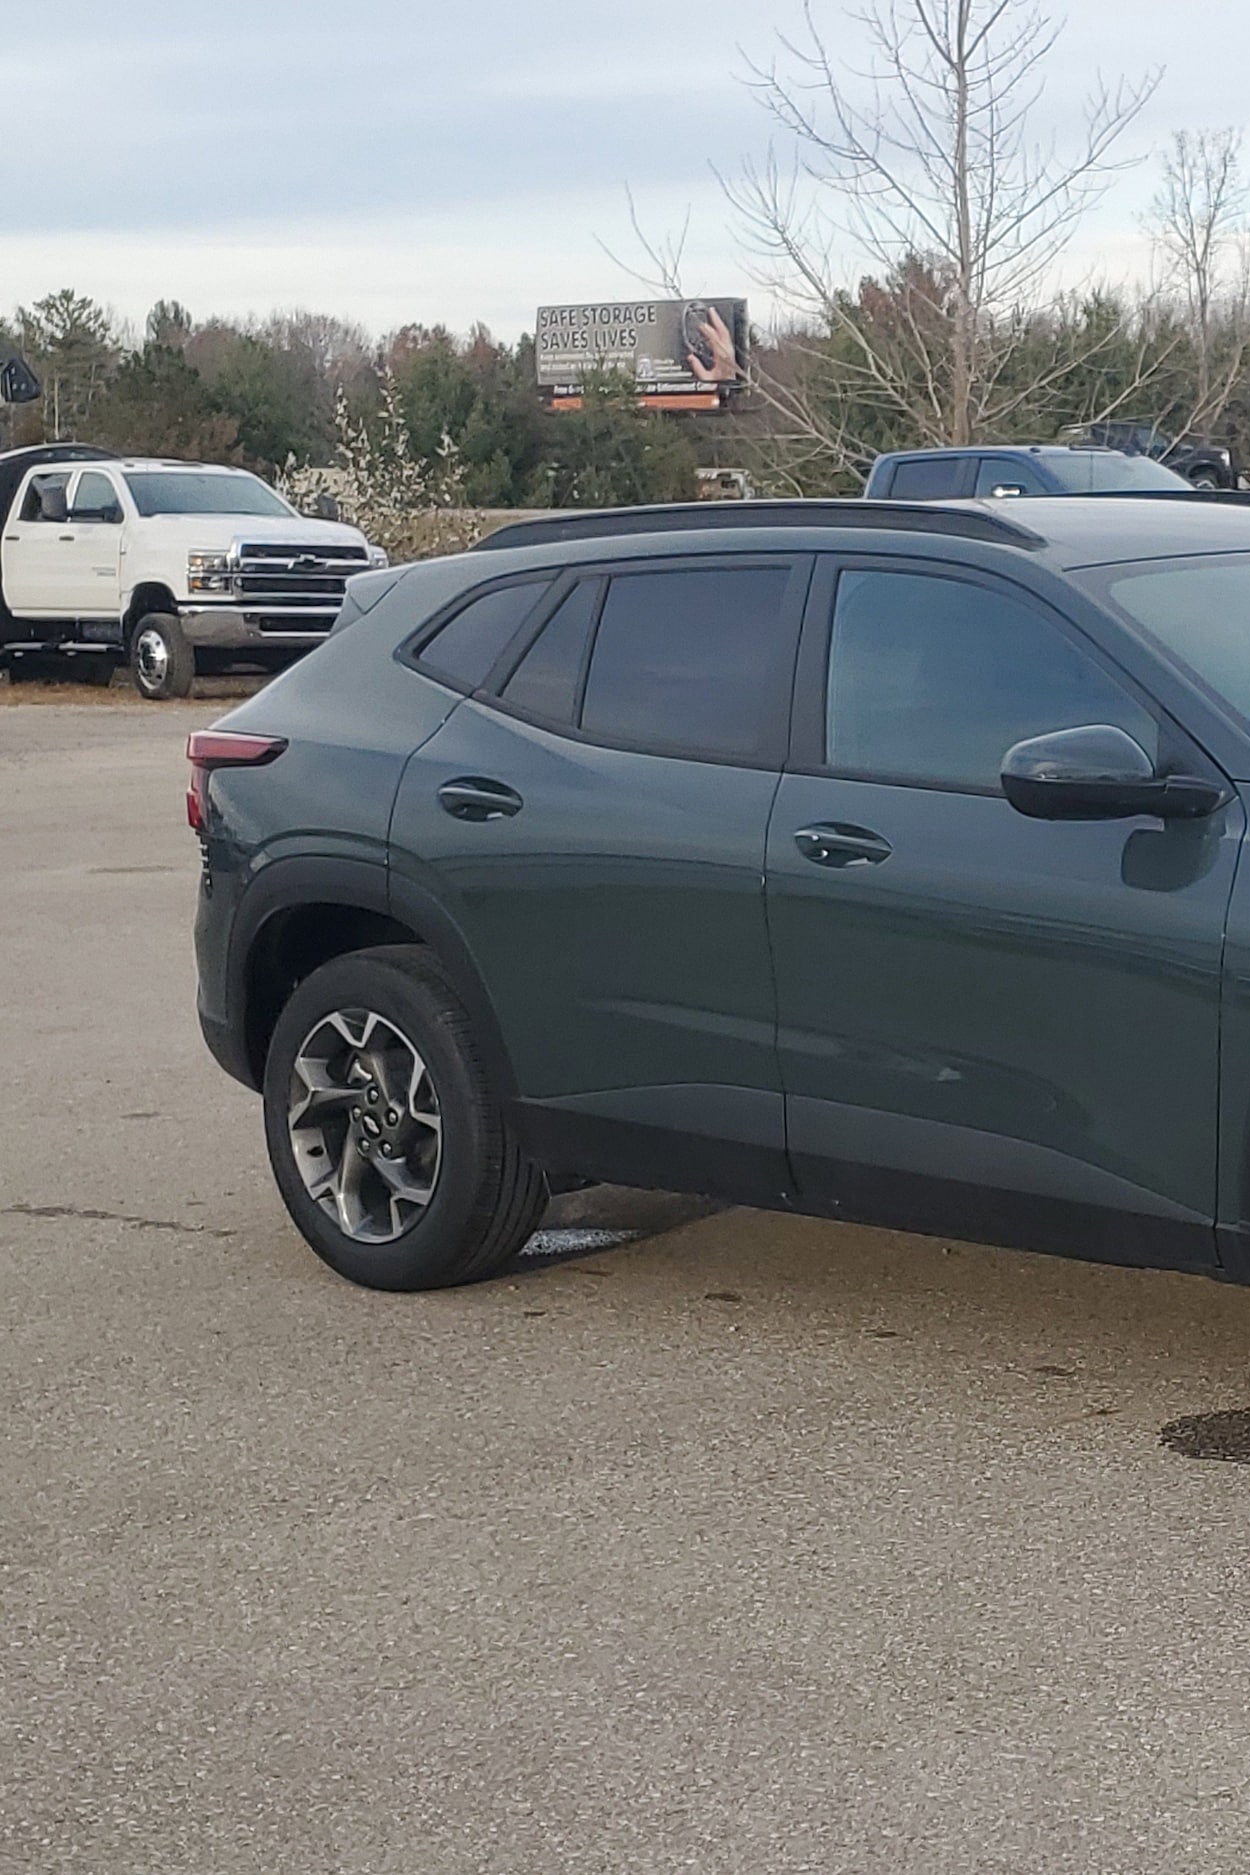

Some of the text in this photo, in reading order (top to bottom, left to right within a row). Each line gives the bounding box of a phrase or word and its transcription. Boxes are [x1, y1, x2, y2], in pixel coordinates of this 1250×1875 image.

[540, 305, 656, 328] SAFE STORAGE
[541, 328, 636, 350] SAVES LIVES
